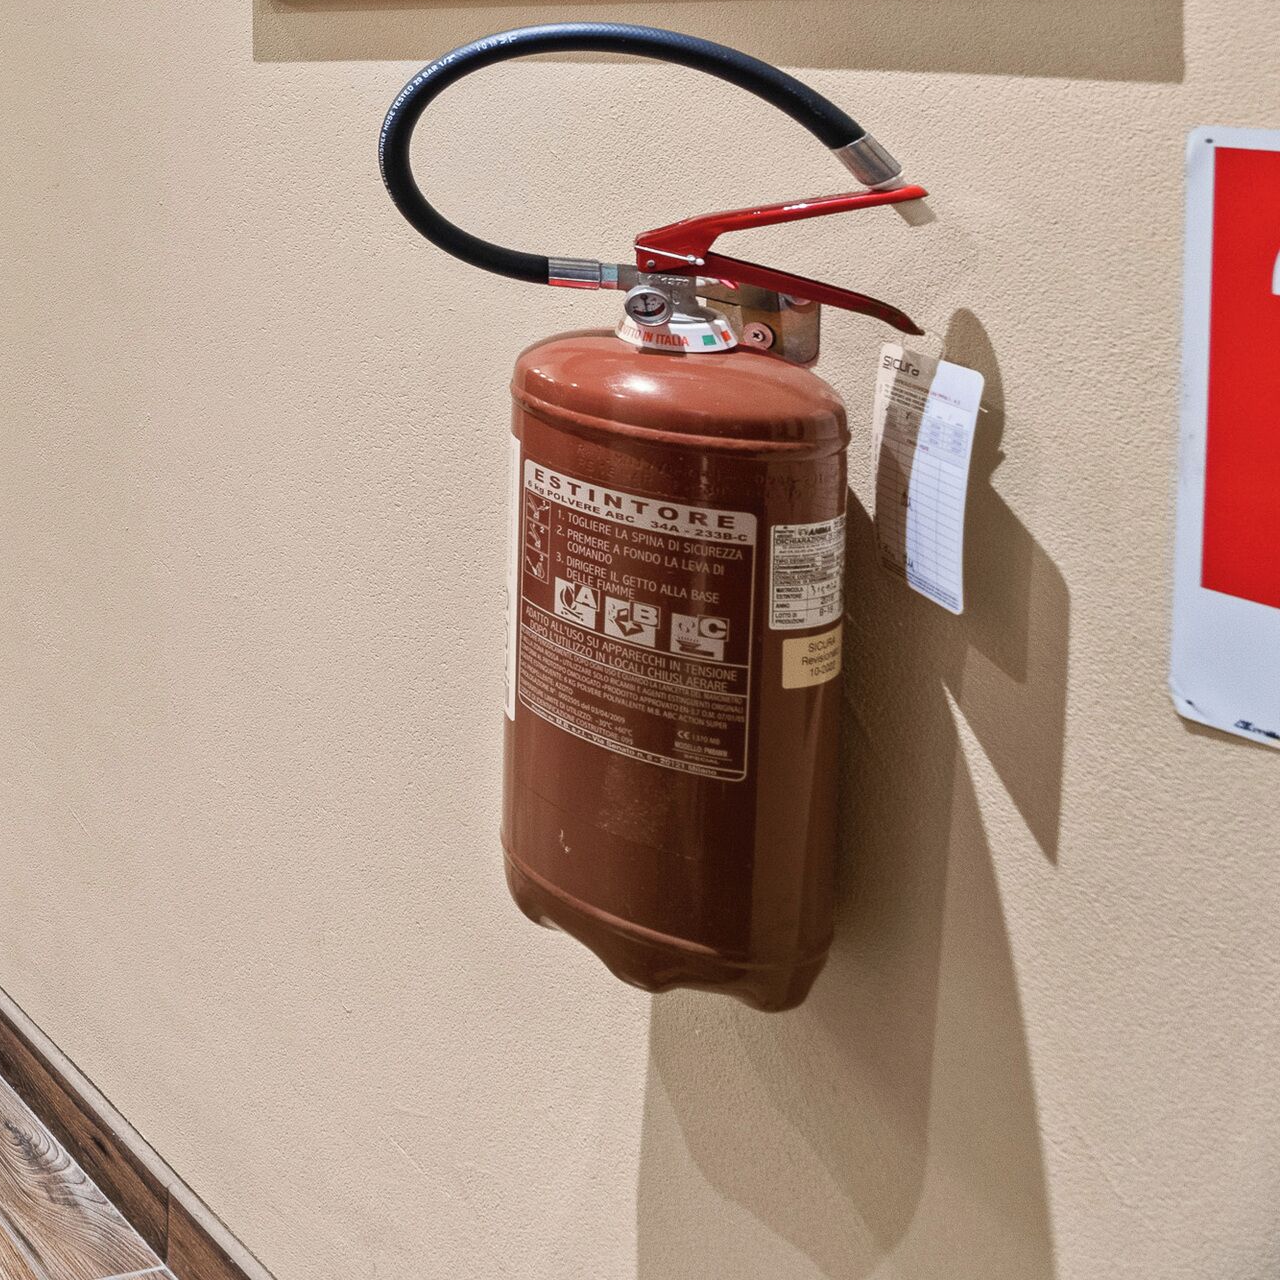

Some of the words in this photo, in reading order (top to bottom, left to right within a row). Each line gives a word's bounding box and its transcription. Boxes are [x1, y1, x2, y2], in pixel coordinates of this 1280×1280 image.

[392, 84, 414, 110] TESTED
[421, 64, 439, 79] BAR
[535, 468, 735, 529] ESTINTORE
[547, 489, 601, 514] POLVERE
[605, 510, 635, 523] ABC
[650, 520, 680, 533] 34A
[694, 528, 748, 542] 233B-C
[566, 540, 613, 565] COMANDO
[567, 512, 611, 536] TOGLIERE
[615, 527, 629, 540] LA
[631, 531, 665, 548] SPINA
[668, 539, 680, 552] DI
[683, 542, 743, 560] SICUREZZA
[567, 528, 610, 553] PREMERE
[612, 543, 620, 555] A
[623, 546, 661, 565] FONDO
[664, 555, 679, 569] LA
[681, 558, 710, 574] LEVA
[713, 563, 725, 575] DI
[566, 555, 608, 579] DIRIGERE
[610, 571, 620, 583] IL
[622, 575, 657, 592] GETTO
[660, 583, 687, 598] ALLA
[690, 589, 720, 604] BASE
[566, 567, 595, 587] DELLE
[597, 578, 636, 600] FIAMME
[525, 606, 550, 627] ADATTO
[551, 619, 584, 643] ALL'USO
[587, 635, 600, 648] SU
[602, 641, 666, 669] APPARECCHI
[669, 660, 681, 672] IN
[686, 663, 738, 682] TENSIONE
[529, 619, 549, 638] DOPO
[549, 631, 593, 658] L'UTILIZZO
[594, 650, 606, 663] IN
[608, 656, 644, 676] LOCALI
[685, 677, 729, 693] AERARE
